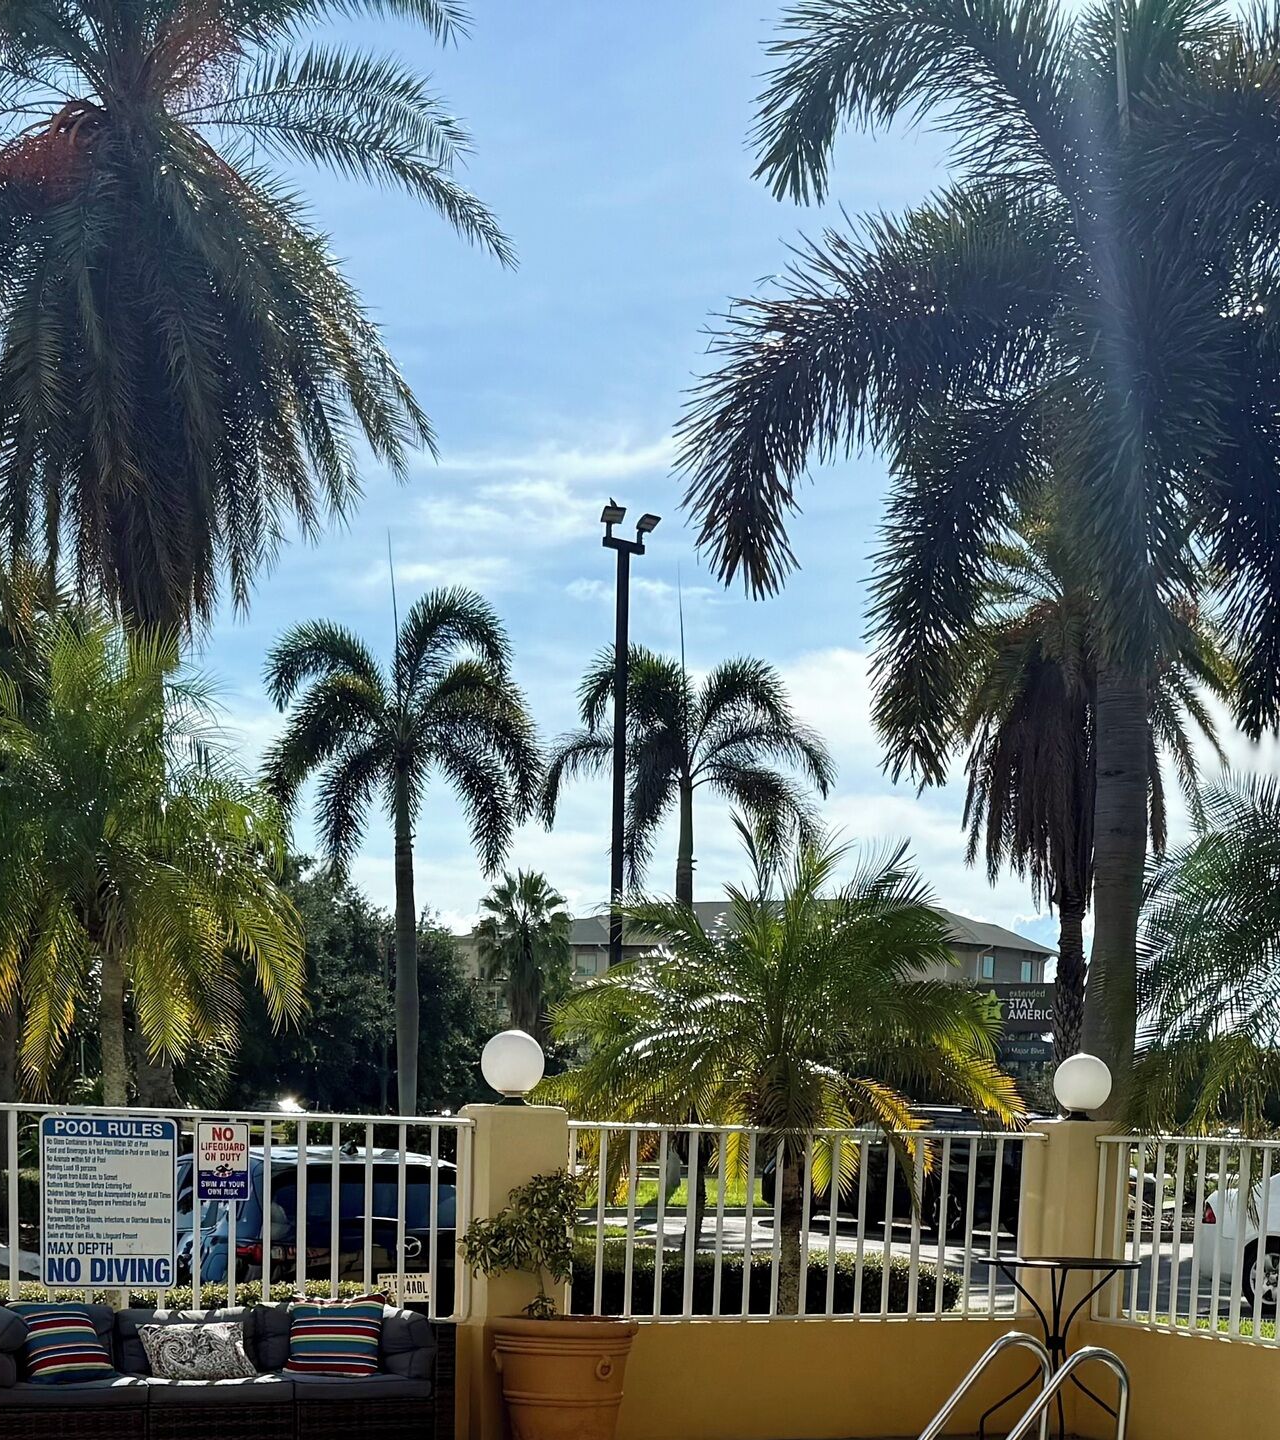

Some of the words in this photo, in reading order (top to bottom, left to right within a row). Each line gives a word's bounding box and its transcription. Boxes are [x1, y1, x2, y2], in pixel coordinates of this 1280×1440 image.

[1009, 989, 1046, 998] extended
[1008, 998, 1036, 1009] STAY
[1007, 1009, 1053, 1020] AMERIC
[54, 1120, 102, 1135] POOL
[108, 1122, 163, 1137] RULES
[212, 1127, 234, 1141] NO
[201, 1143, 245, 1152] LIFEGUARD
[205, 1152, 216, 1161] ON
[220, 1153, 241, 1161] DUTY
[201, 1180, 217, 1188] SWIM
[207, 1188, 221, 1196] OWN
[224, 1188, 239, 1196] RISK
[47, 1242, 74, 1255] MAX
[78, 1242, 113, 1255] DEPTH
[47, 1257, 81, 1282] NO
[90, 1258, 170, 1283] DIVING
